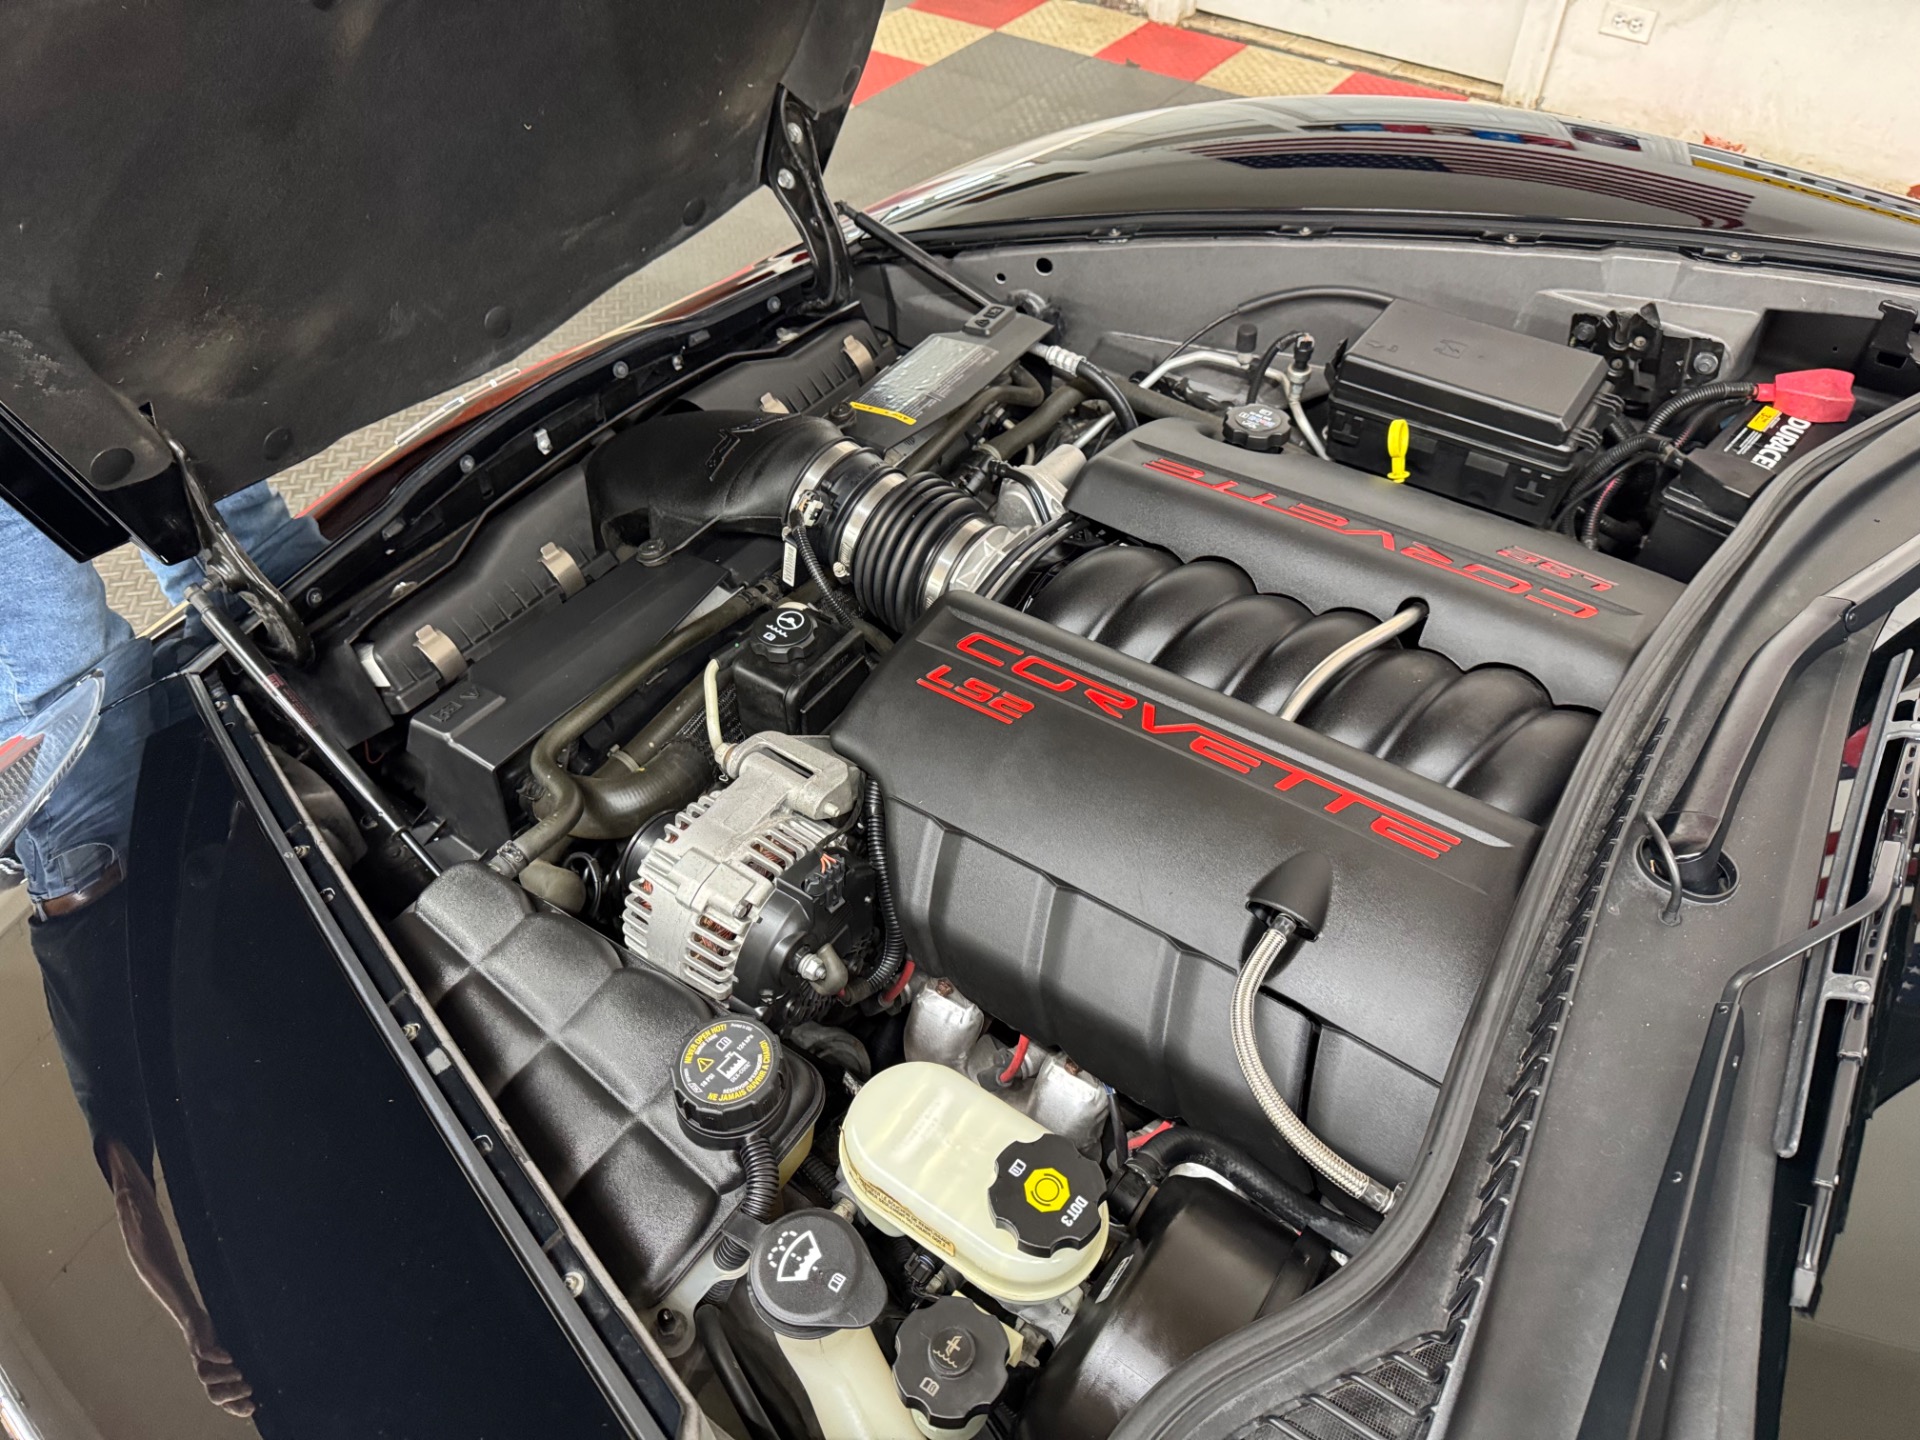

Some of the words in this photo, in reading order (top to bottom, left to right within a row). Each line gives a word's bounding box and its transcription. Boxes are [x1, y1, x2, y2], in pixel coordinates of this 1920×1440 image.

[1750, 416, 1812, 470] DURACE
[1142, 458, 1599, 619] CORVETTE
[1496, 548, 1615, 592] LS2
[920, 664, 1035, 722] LS2
[956, 631, 1462, 860] CORVETTE
[684, 1043, 696, 1064] NEVER
[695, 1030, 711, 1043] OPEN
[711, 1024, 727, 1034] HOT!
[736, 1042, 747, 1051] 124
[706, 1073, 716, 1083] PSI
[707, 1092, 719, 1101] NE
[718, 1087, 747, 1101] JAMAIS
[746, 1070, 767, 1091] OUVRIR
[1060, 1215, 1074, 1227] 3
[1067, 1195, 1089, 1221] DOT
